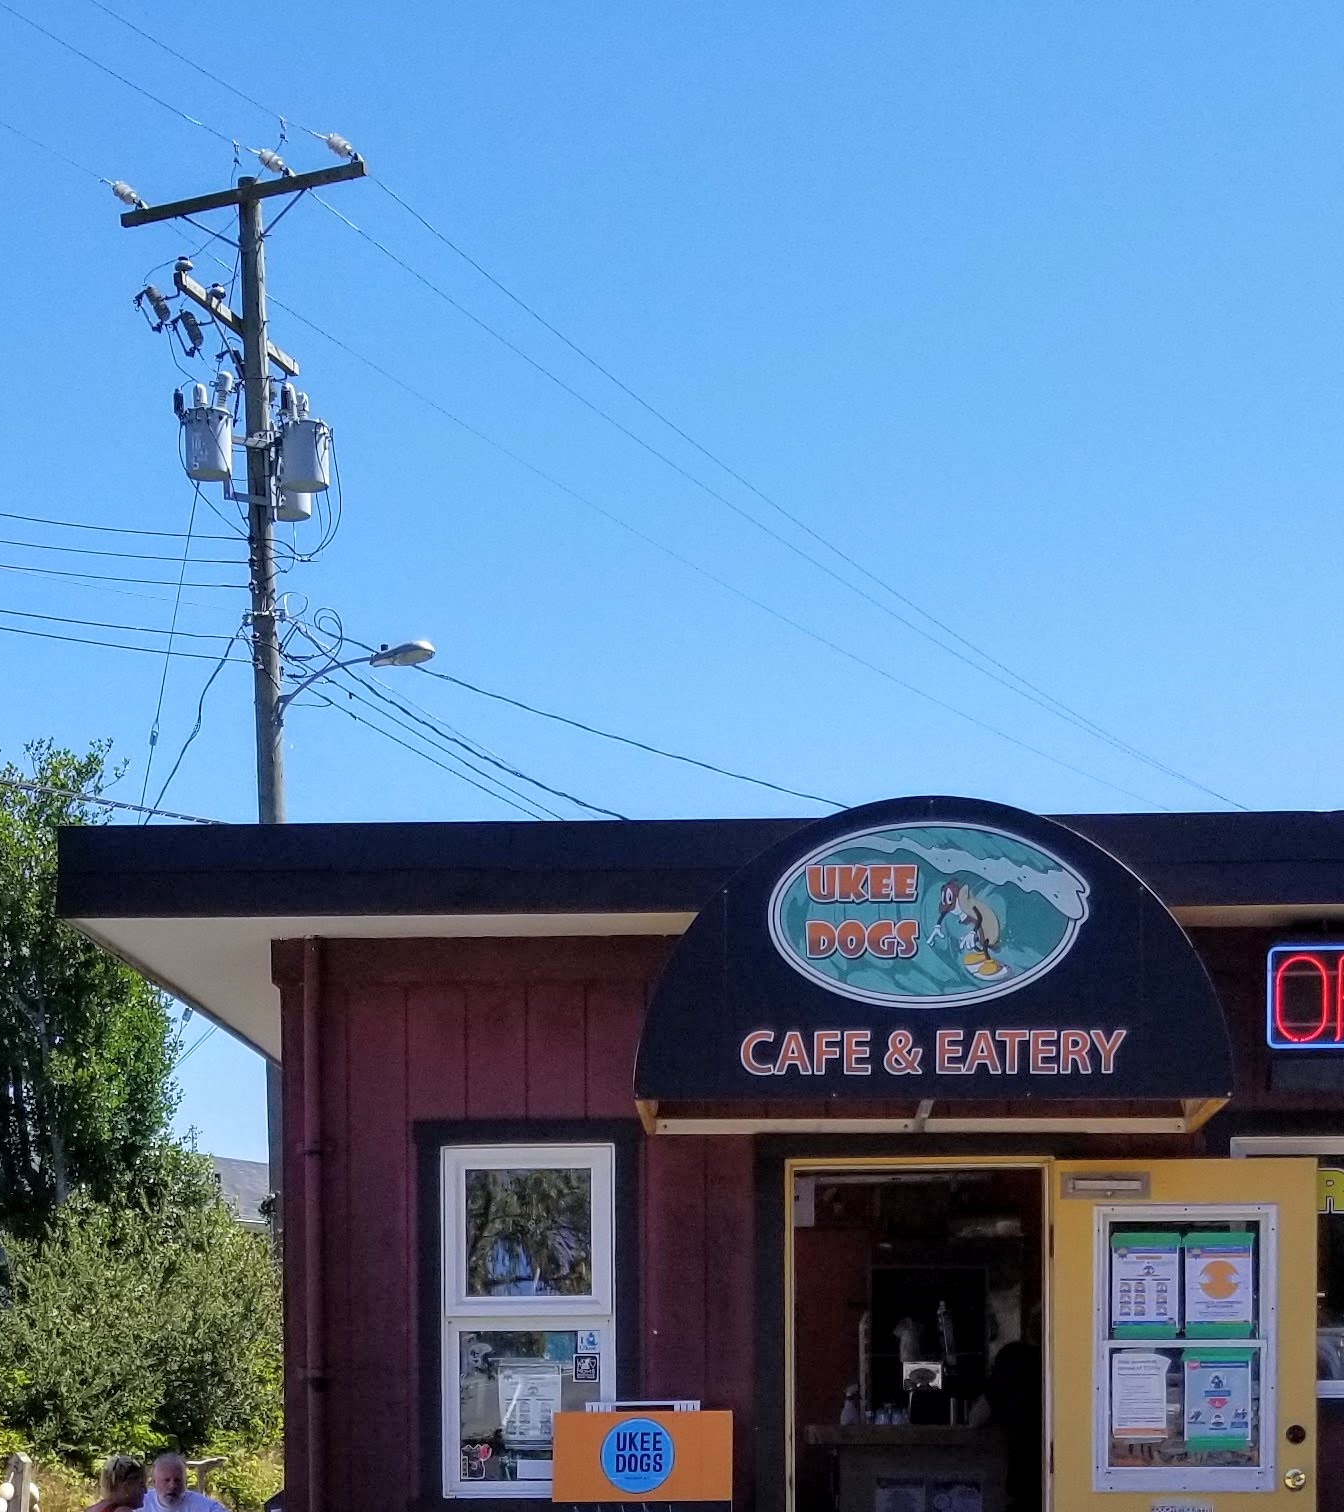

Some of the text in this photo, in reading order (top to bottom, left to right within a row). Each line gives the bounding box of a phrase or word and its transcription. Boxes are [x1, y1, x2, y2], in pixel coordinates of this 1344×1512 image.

[805, 863, 919, 904] UKEE
[805, 919, 919, 959] DOGS
[740, 1028, 1127, 1076] CAFE & EATERY
[616, 1431, 663, 1452] UKEE
[616, 1453, 663, 1473] DOGS
